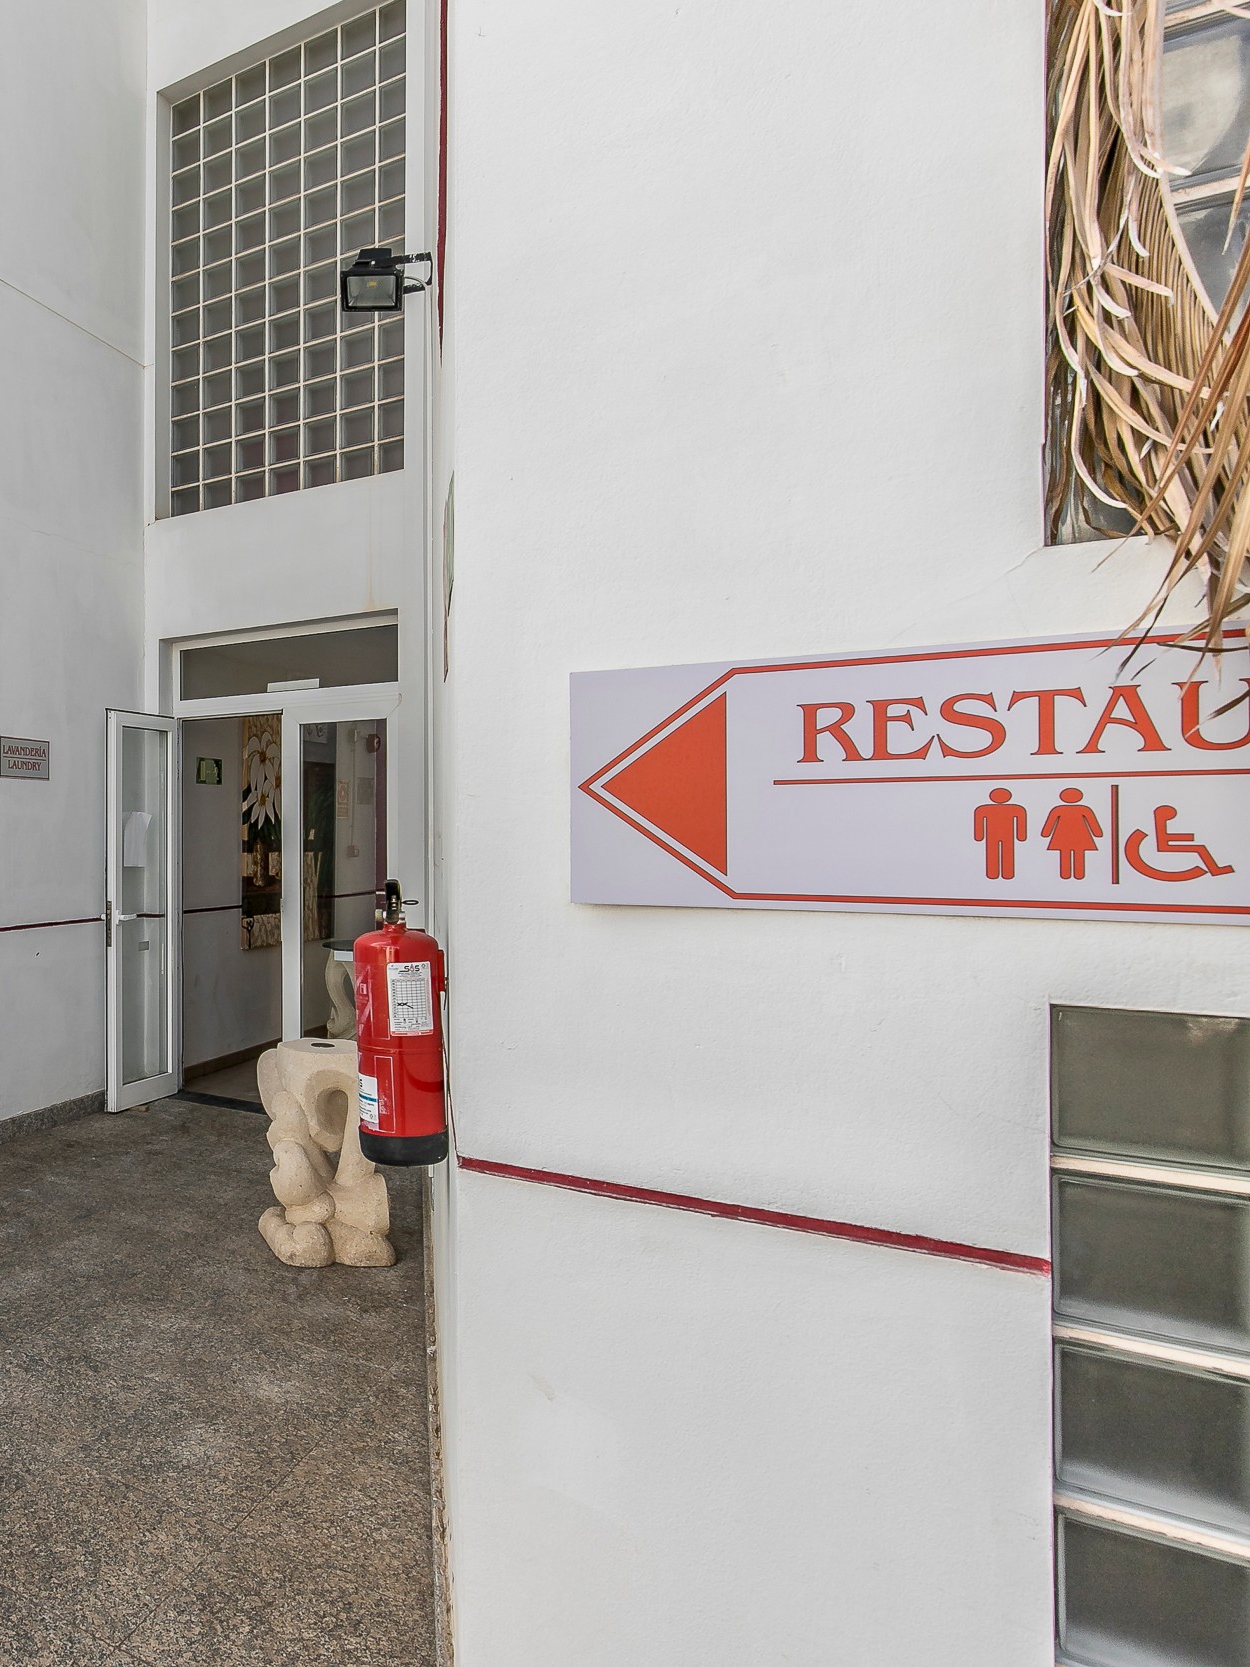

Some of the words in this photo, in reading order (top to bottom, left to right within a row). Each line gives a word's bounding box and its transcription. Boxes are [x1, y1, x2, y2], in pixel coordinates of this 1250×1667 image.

[796, 677, 1250, 763] RESTAU
[2, 744, 47, 758] LAVANDERÍA
[7, 759, 42, 771] LAUNDRY
